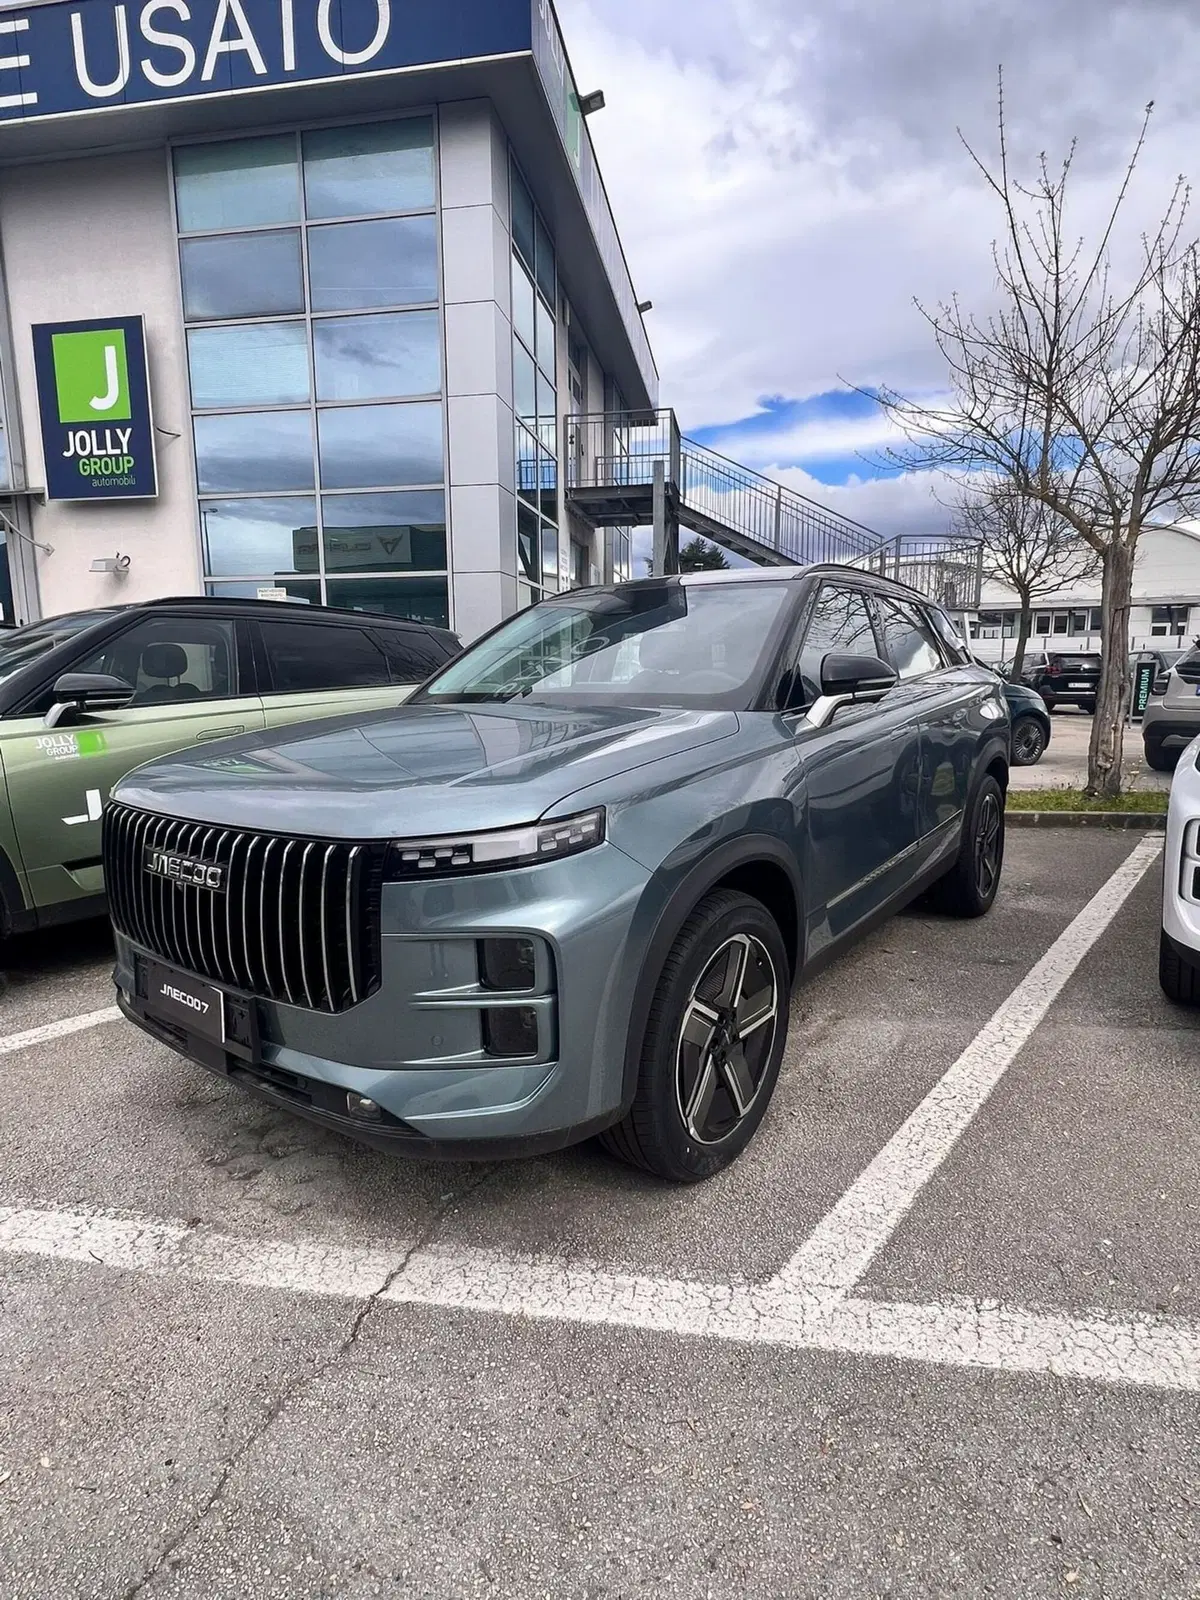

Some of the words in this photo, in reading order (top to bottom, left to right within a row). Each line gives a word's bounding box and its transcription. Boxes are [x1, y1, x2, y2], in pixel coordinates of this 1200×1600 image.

[71, 0, 391, 98] USATO
[62, 427, 132, 458] JOLLY
[78, 456, 135, 476] GROUP
[1138, 668, 1150, 711] PREMIUM
[35, 733, 76, 749] JOLLY
[46, 745, 79, 757] GROUP
[147, 852, 223, 889] JAECOO
